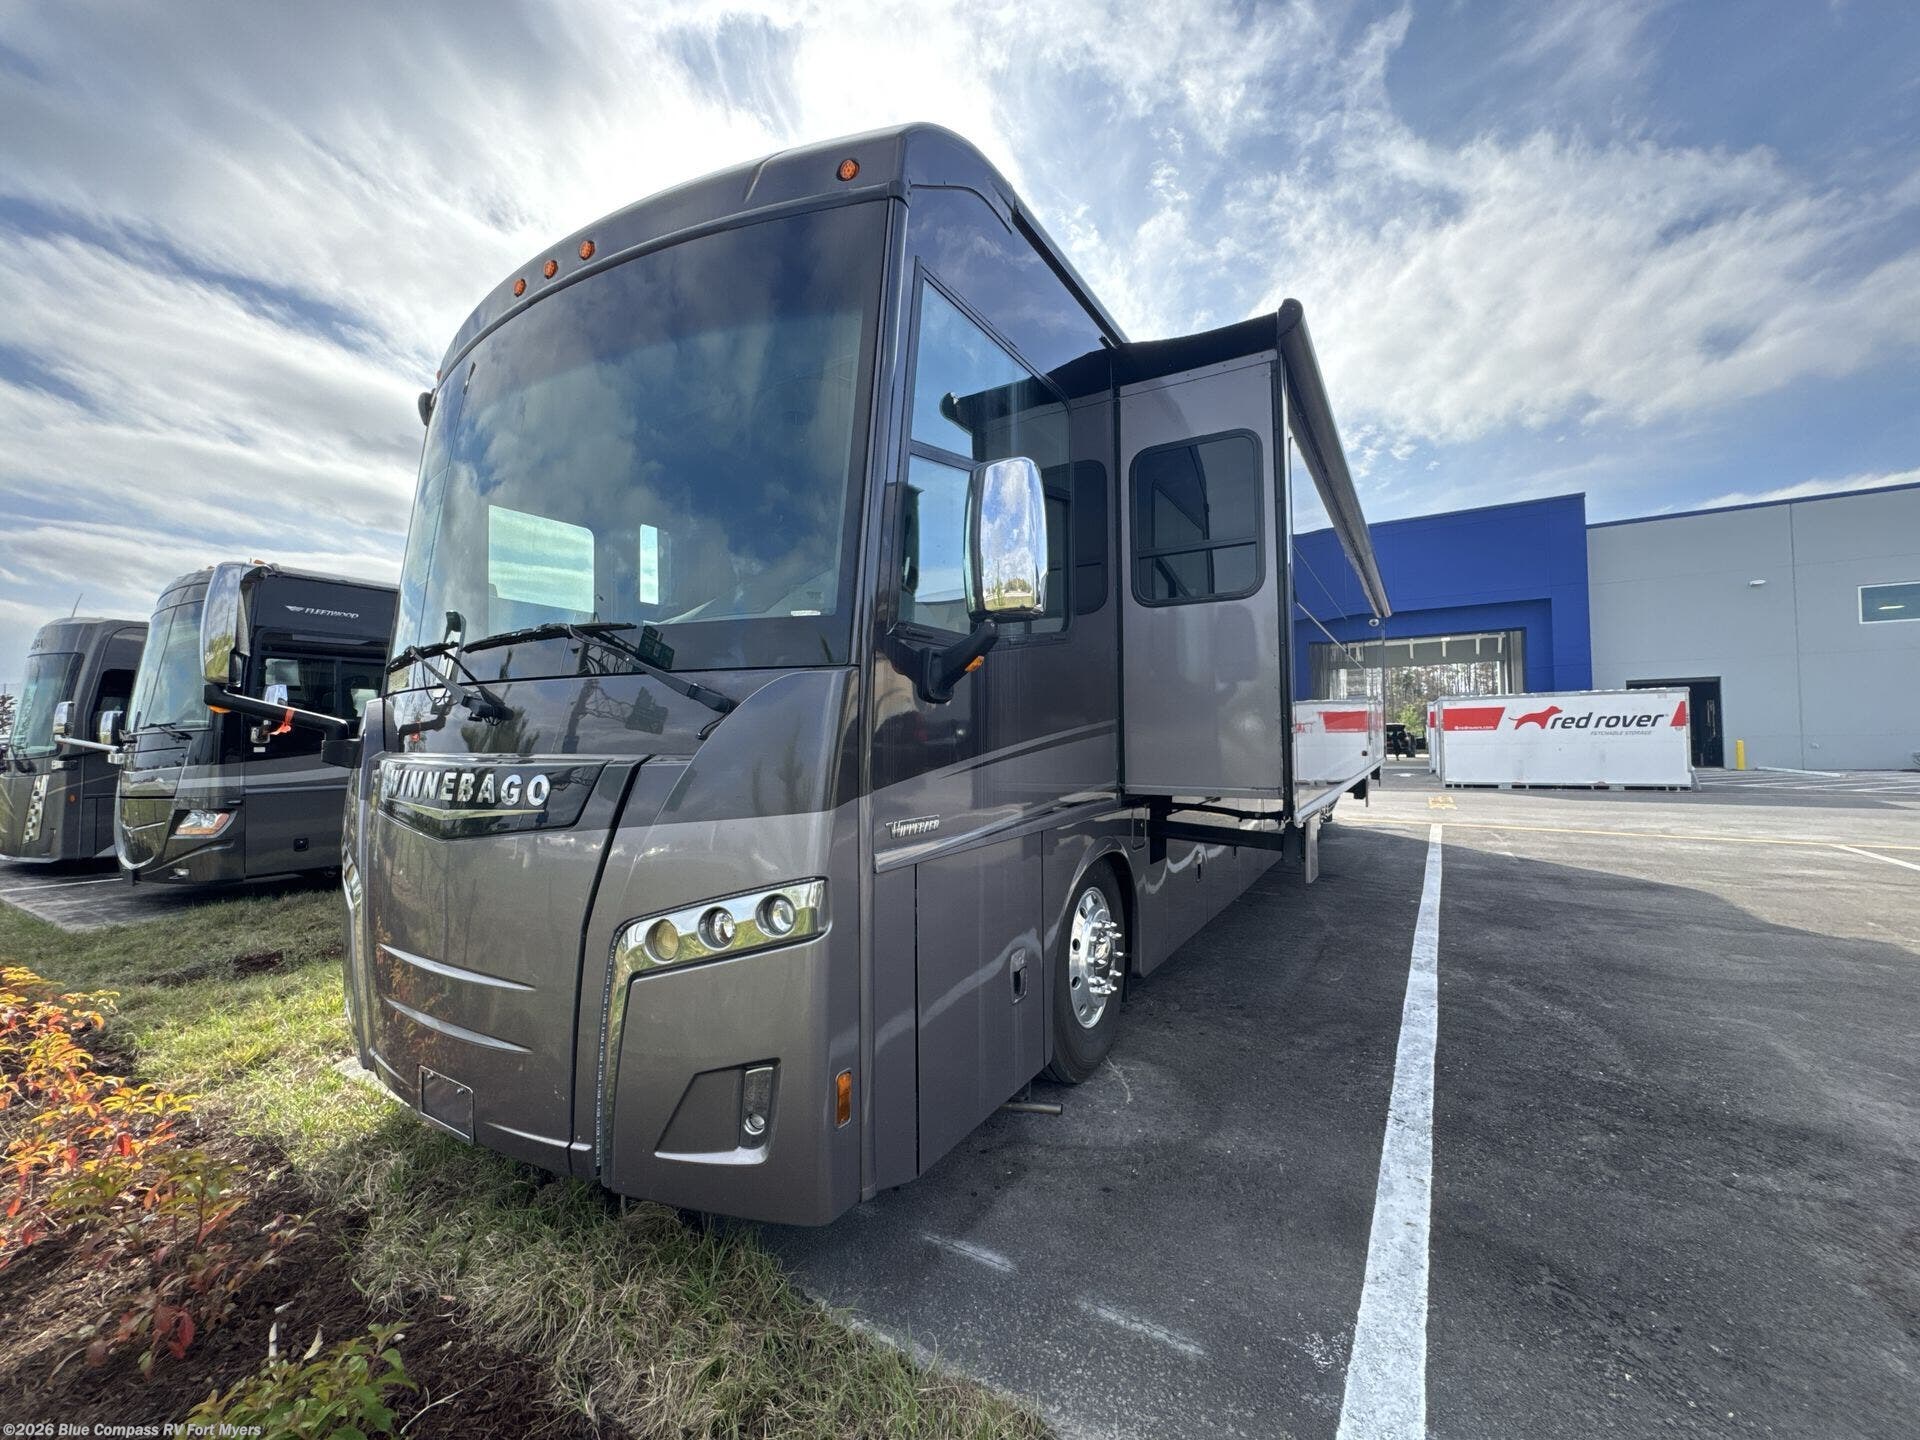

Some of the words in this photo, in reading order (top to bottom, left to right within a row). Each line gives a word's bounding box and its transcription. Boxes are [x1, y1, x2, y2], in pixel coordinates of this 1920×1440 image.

[305, 607, 359, 619] FLEETWOOD
[1550, 712, 1594, 730] red
[1594, 713, 1665, 729] rover
[386, 769, 551, 806] WINNEBAGO
